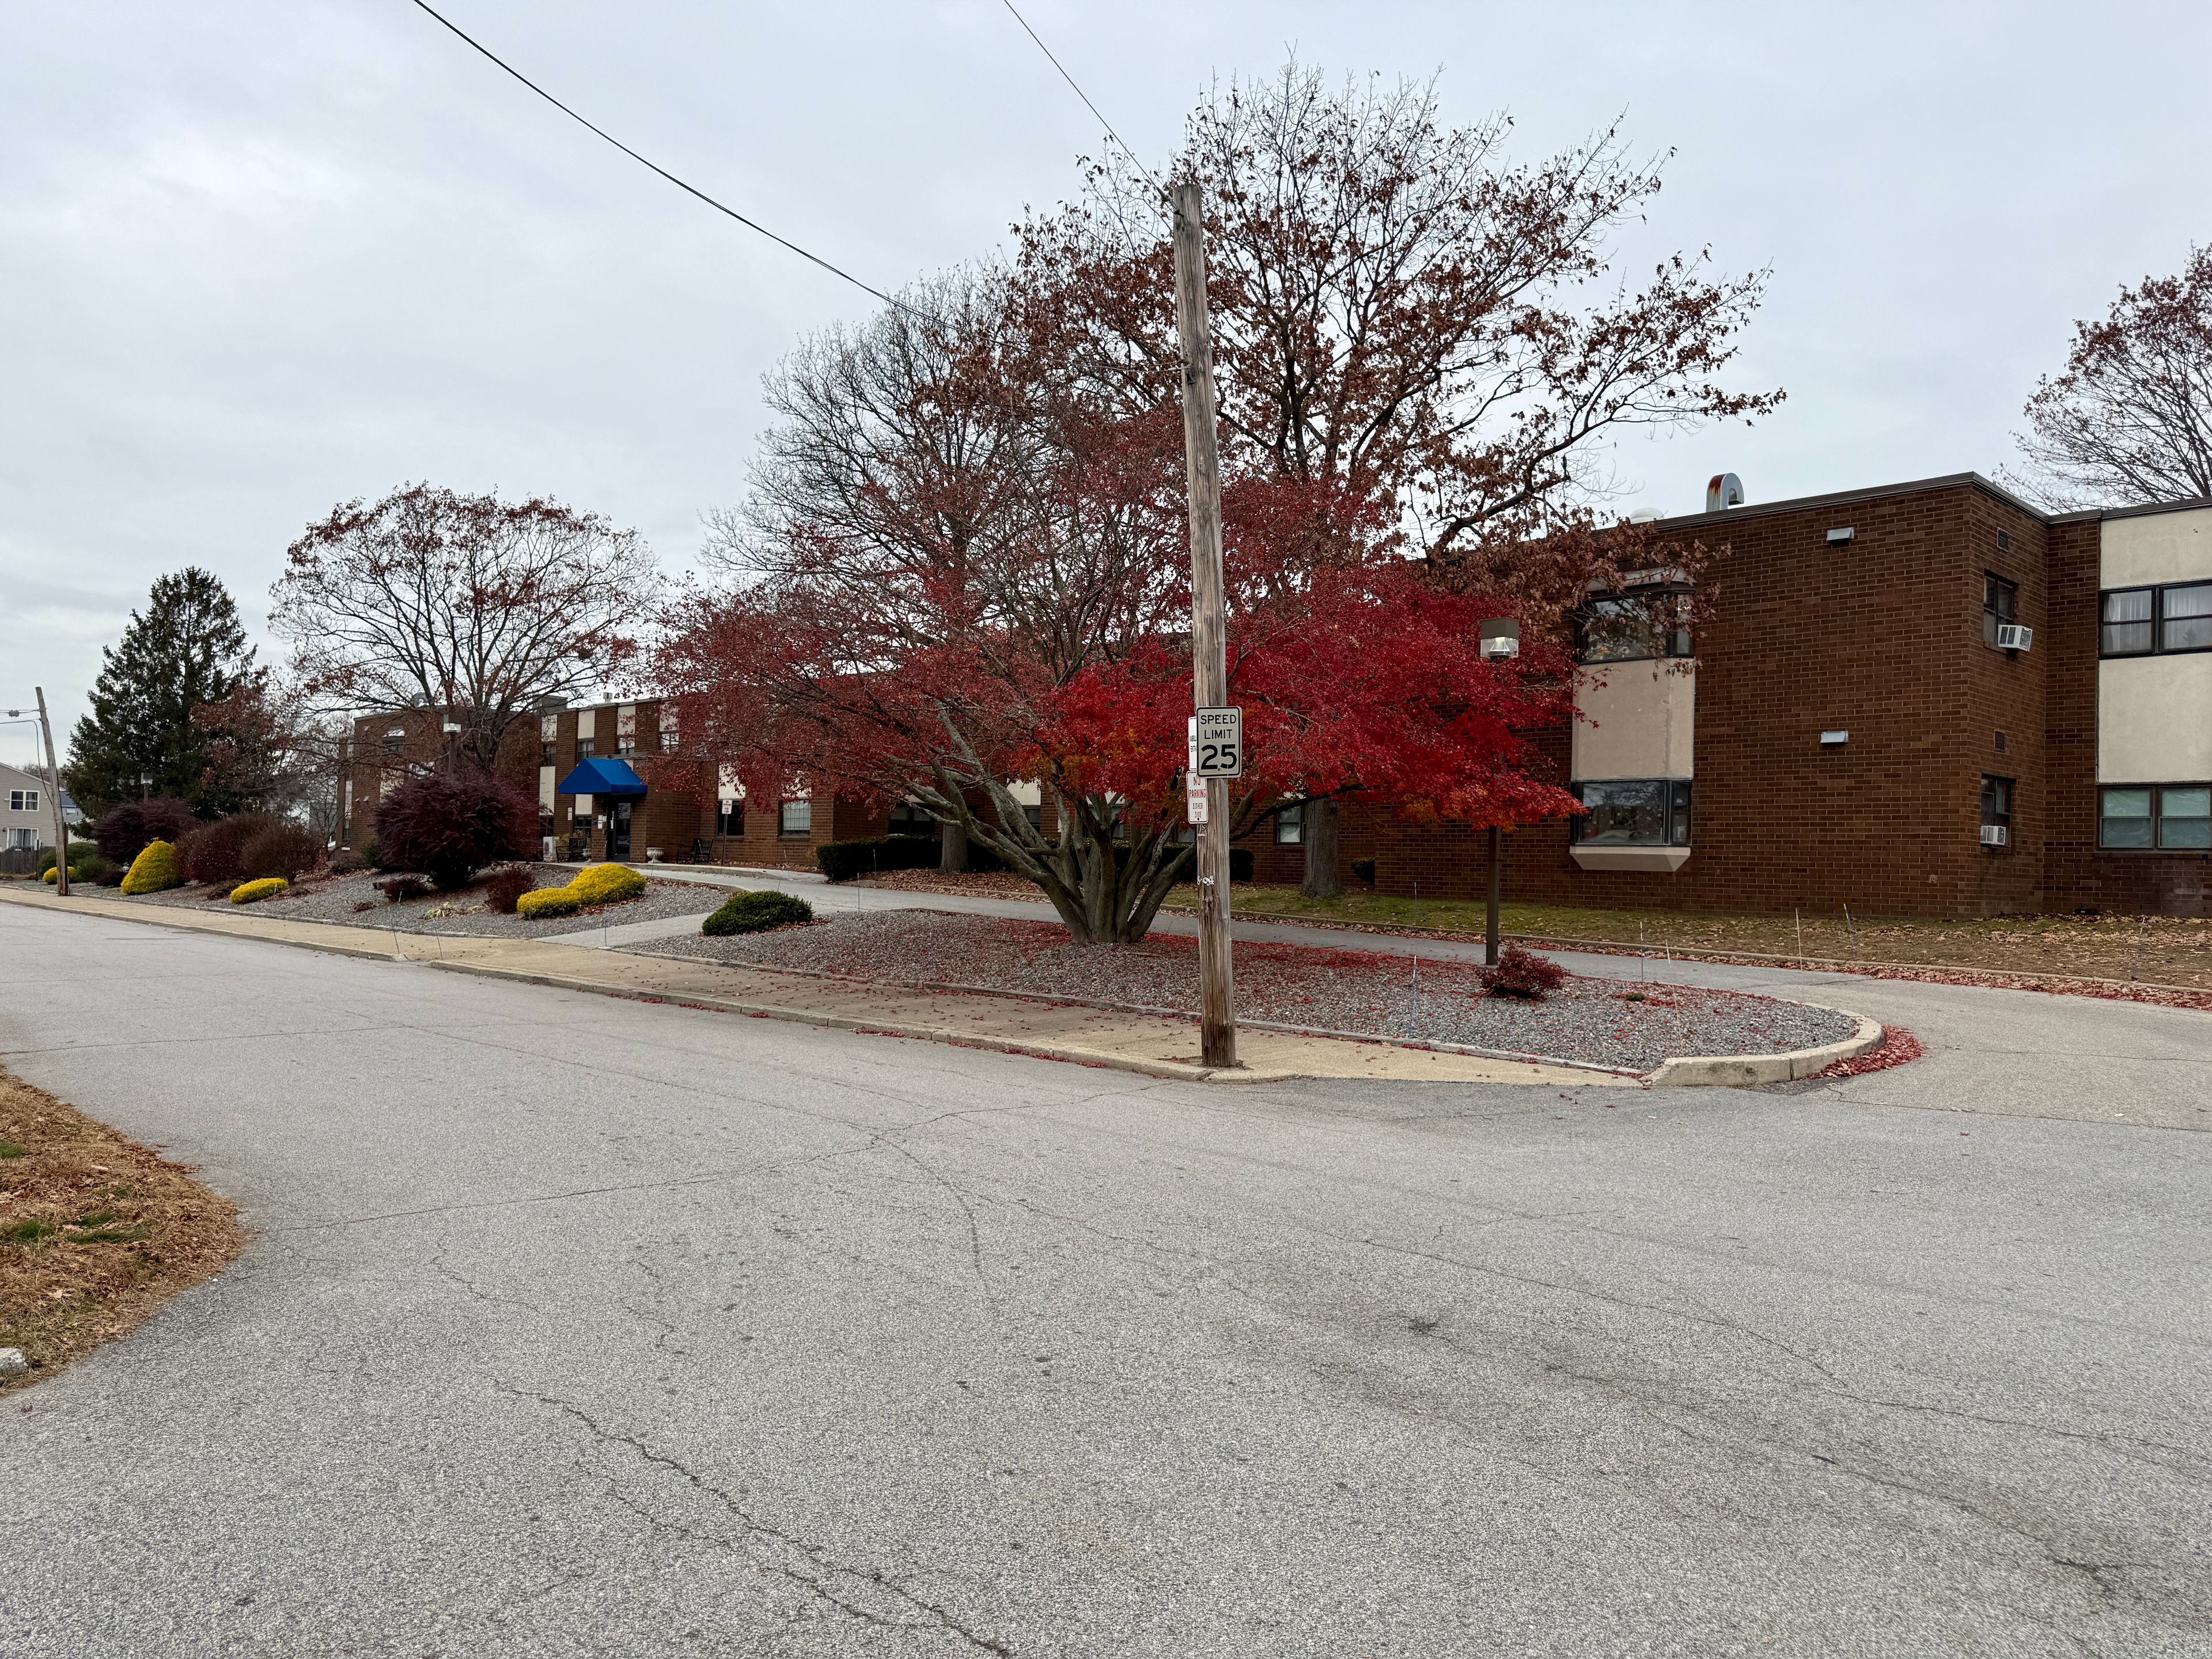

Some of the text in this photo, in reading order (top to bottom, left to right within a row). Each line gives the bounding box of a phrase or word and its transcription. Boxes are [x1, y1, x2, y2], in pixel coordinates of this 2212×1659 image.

[1200, 714, 1236, 724] SPEED
[1205, 729, 1233, 739] LIMIT
[1201, 744, 1237, 770] 25
[1194, 777, 1200, 786] NO
[1190, 789, 1206, 798] PARKING
